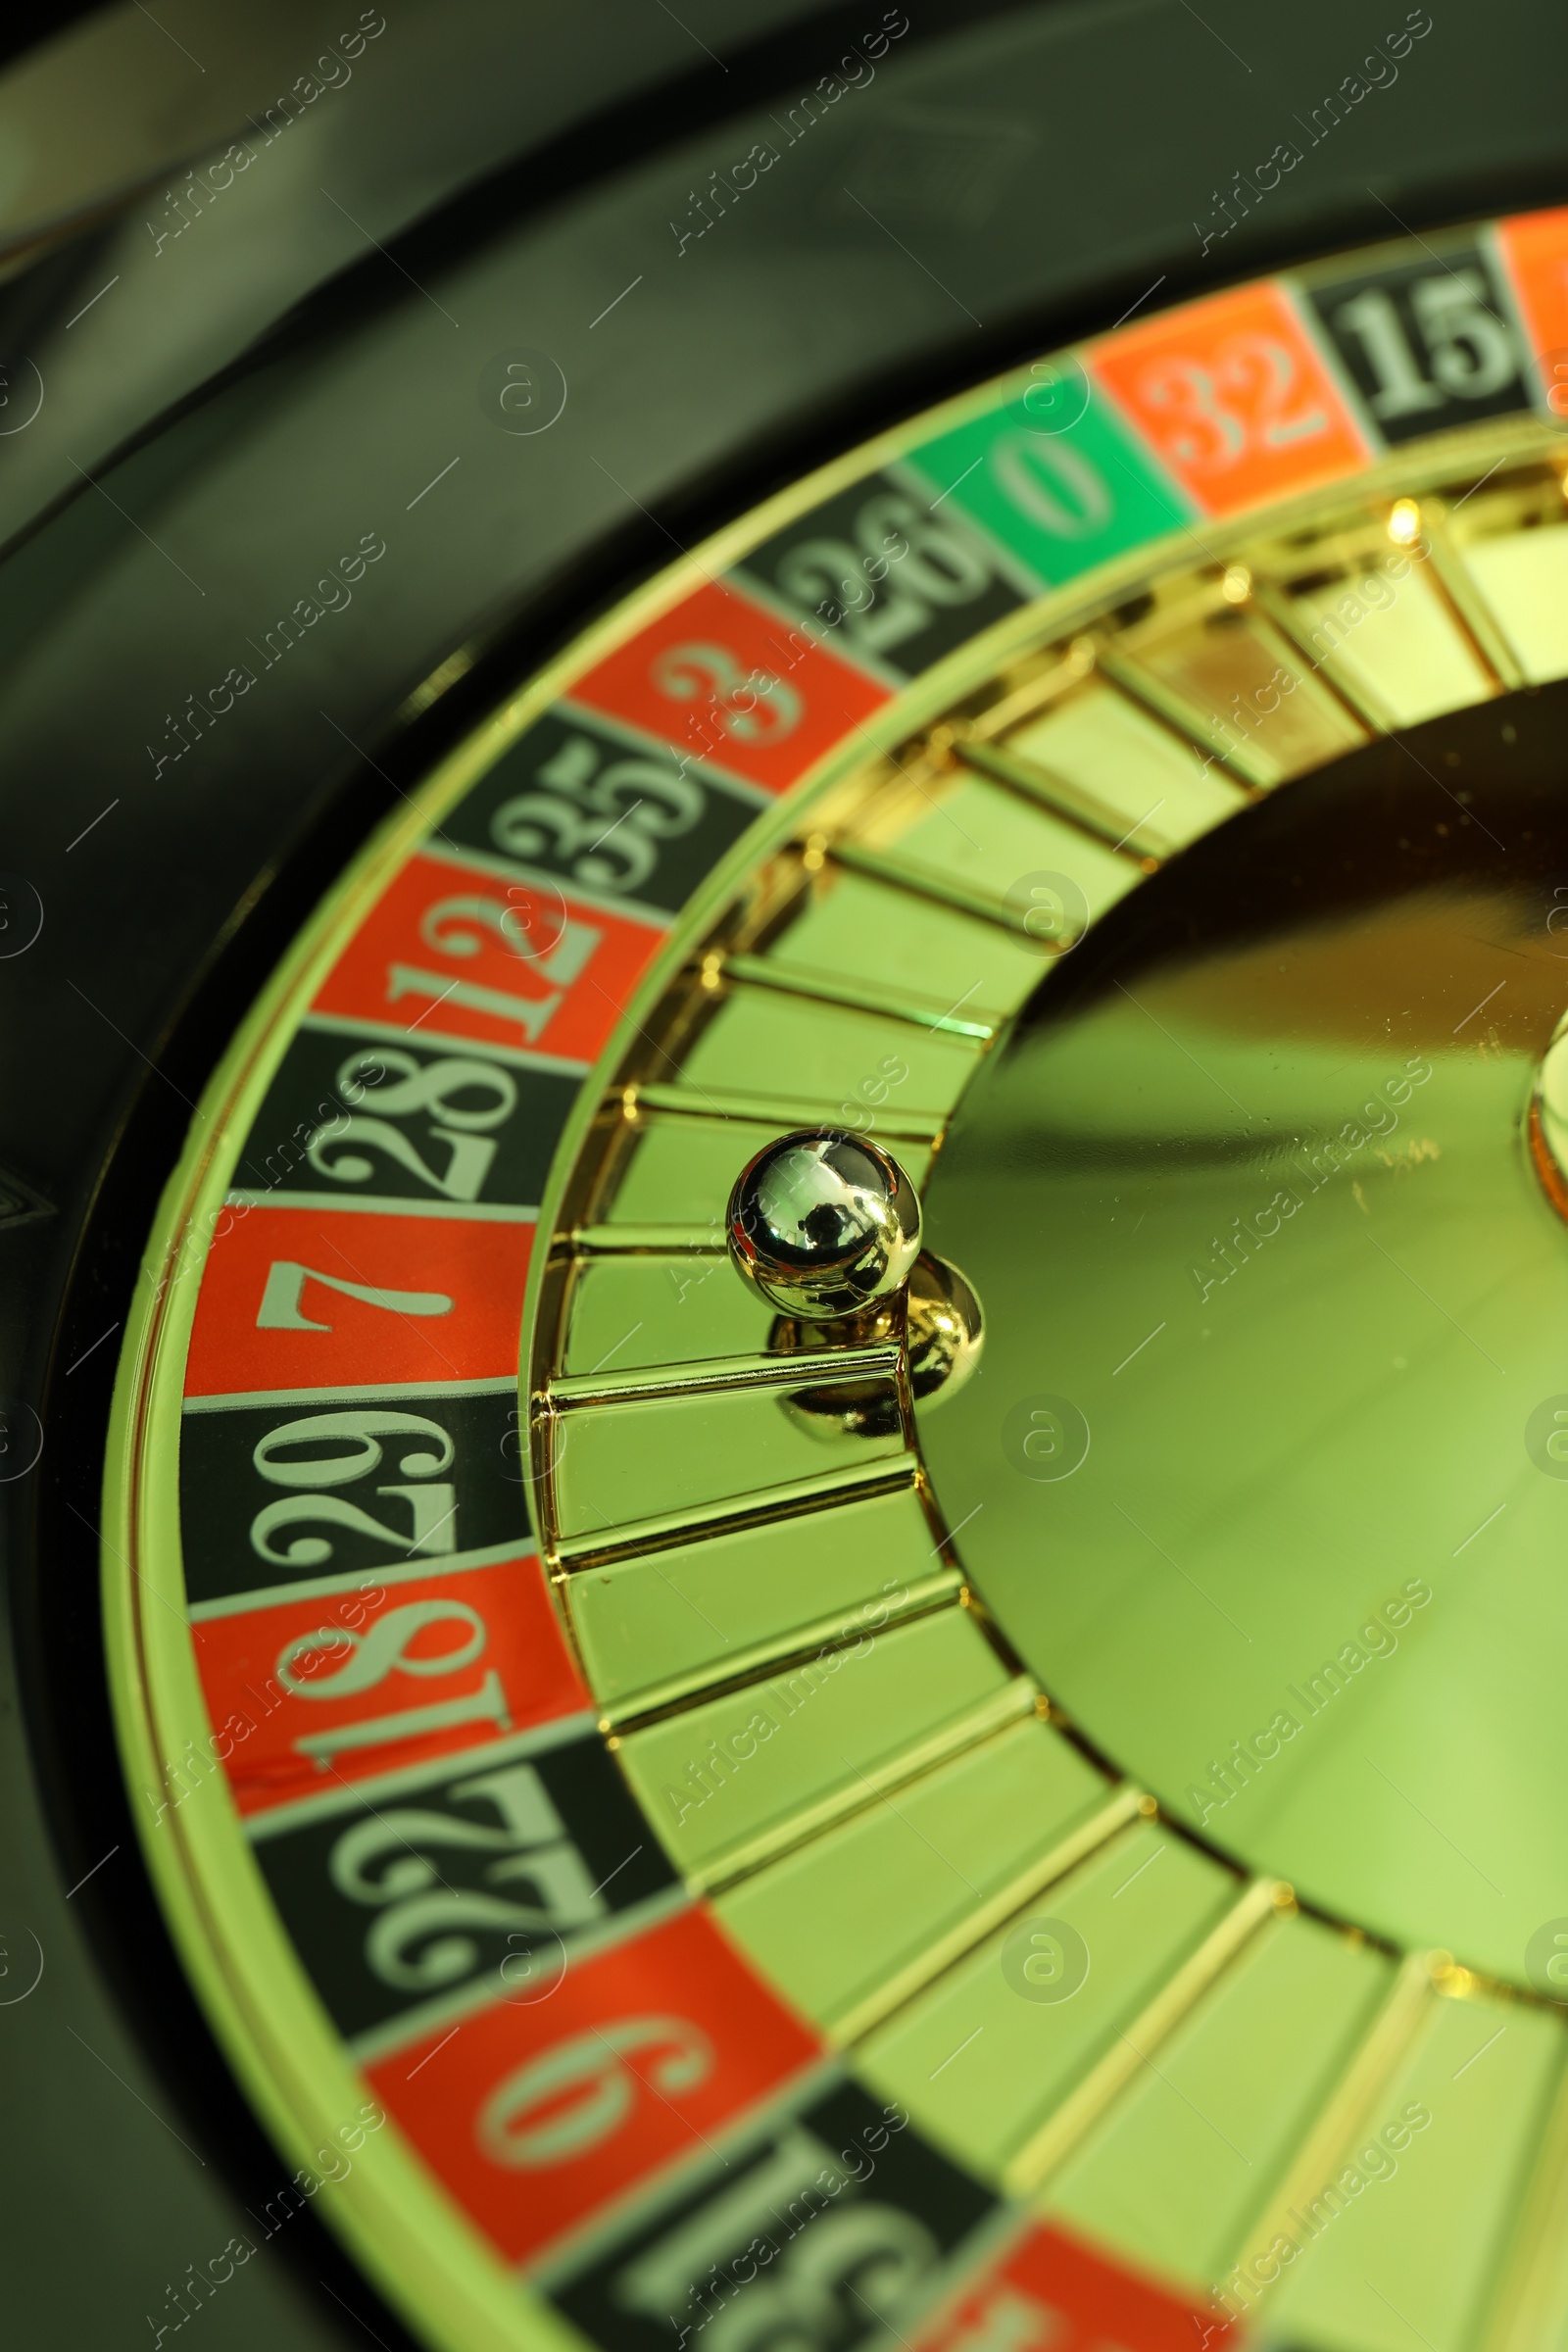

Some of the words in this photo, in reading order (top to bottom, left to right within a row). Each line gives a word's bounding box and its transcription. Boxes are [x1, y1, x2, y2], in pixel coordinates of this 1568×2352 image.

[1140, 331, 1329, 474] 32
[1335, 266, 1512, 417] 15
[988, 432, 1114, 540] 0
[776, 494, 992, 655] 26
[650, 642, 804, 747] 3
[491, 735, 707, 894] 35
[387, 896, 604, 1045] 12
[308, 1049, 516, 1201] 28
[256, 1260, 455, 1333] 7
[250, 1410, 457, 1565] 29
[273, 1598, 512, 1773] 18
[329, 1763, 610, 1990] 22
[472, 2014, 715, 2172] 9
